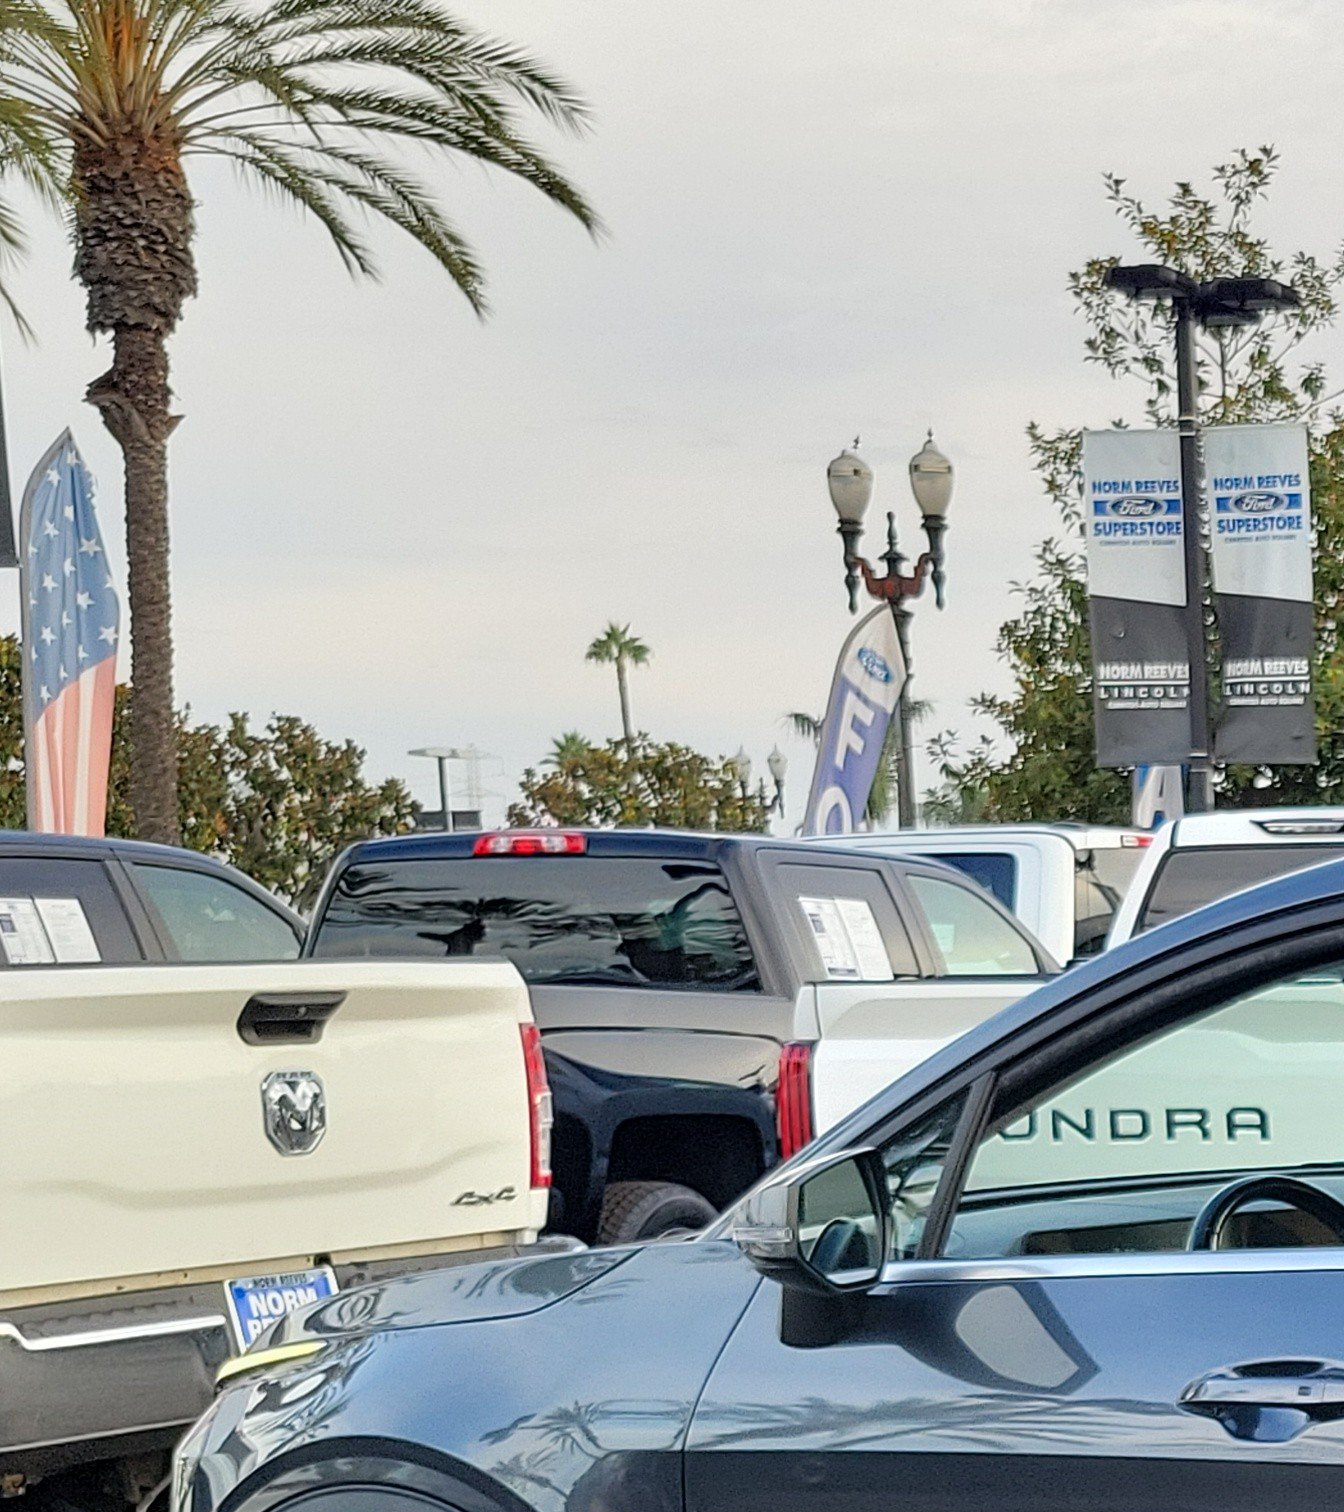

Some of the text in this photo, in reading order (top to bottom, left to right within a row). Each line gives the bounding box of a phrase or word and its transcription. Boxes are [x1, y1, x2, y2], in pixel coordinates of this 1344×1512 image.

[1092, 479, 1180, 494] NORM REEVES
[1213, 474, 1301, 491] NORM REEVES
[1119, 499, 1156, 516] Ford
[1242, 494, 1277, 511] Ford
[1093, 521, 1183, 537] SUPERSTORE
[1217, 515, 1303, 534] SUPERSTORE
[1099, 662, 1142, 679] NORM
[1226, 657, 1309, 676] NORM REEVES
[1223, 681, 1311, 696] LINCOLN
[248, 1287, 318, 1318] NORM
